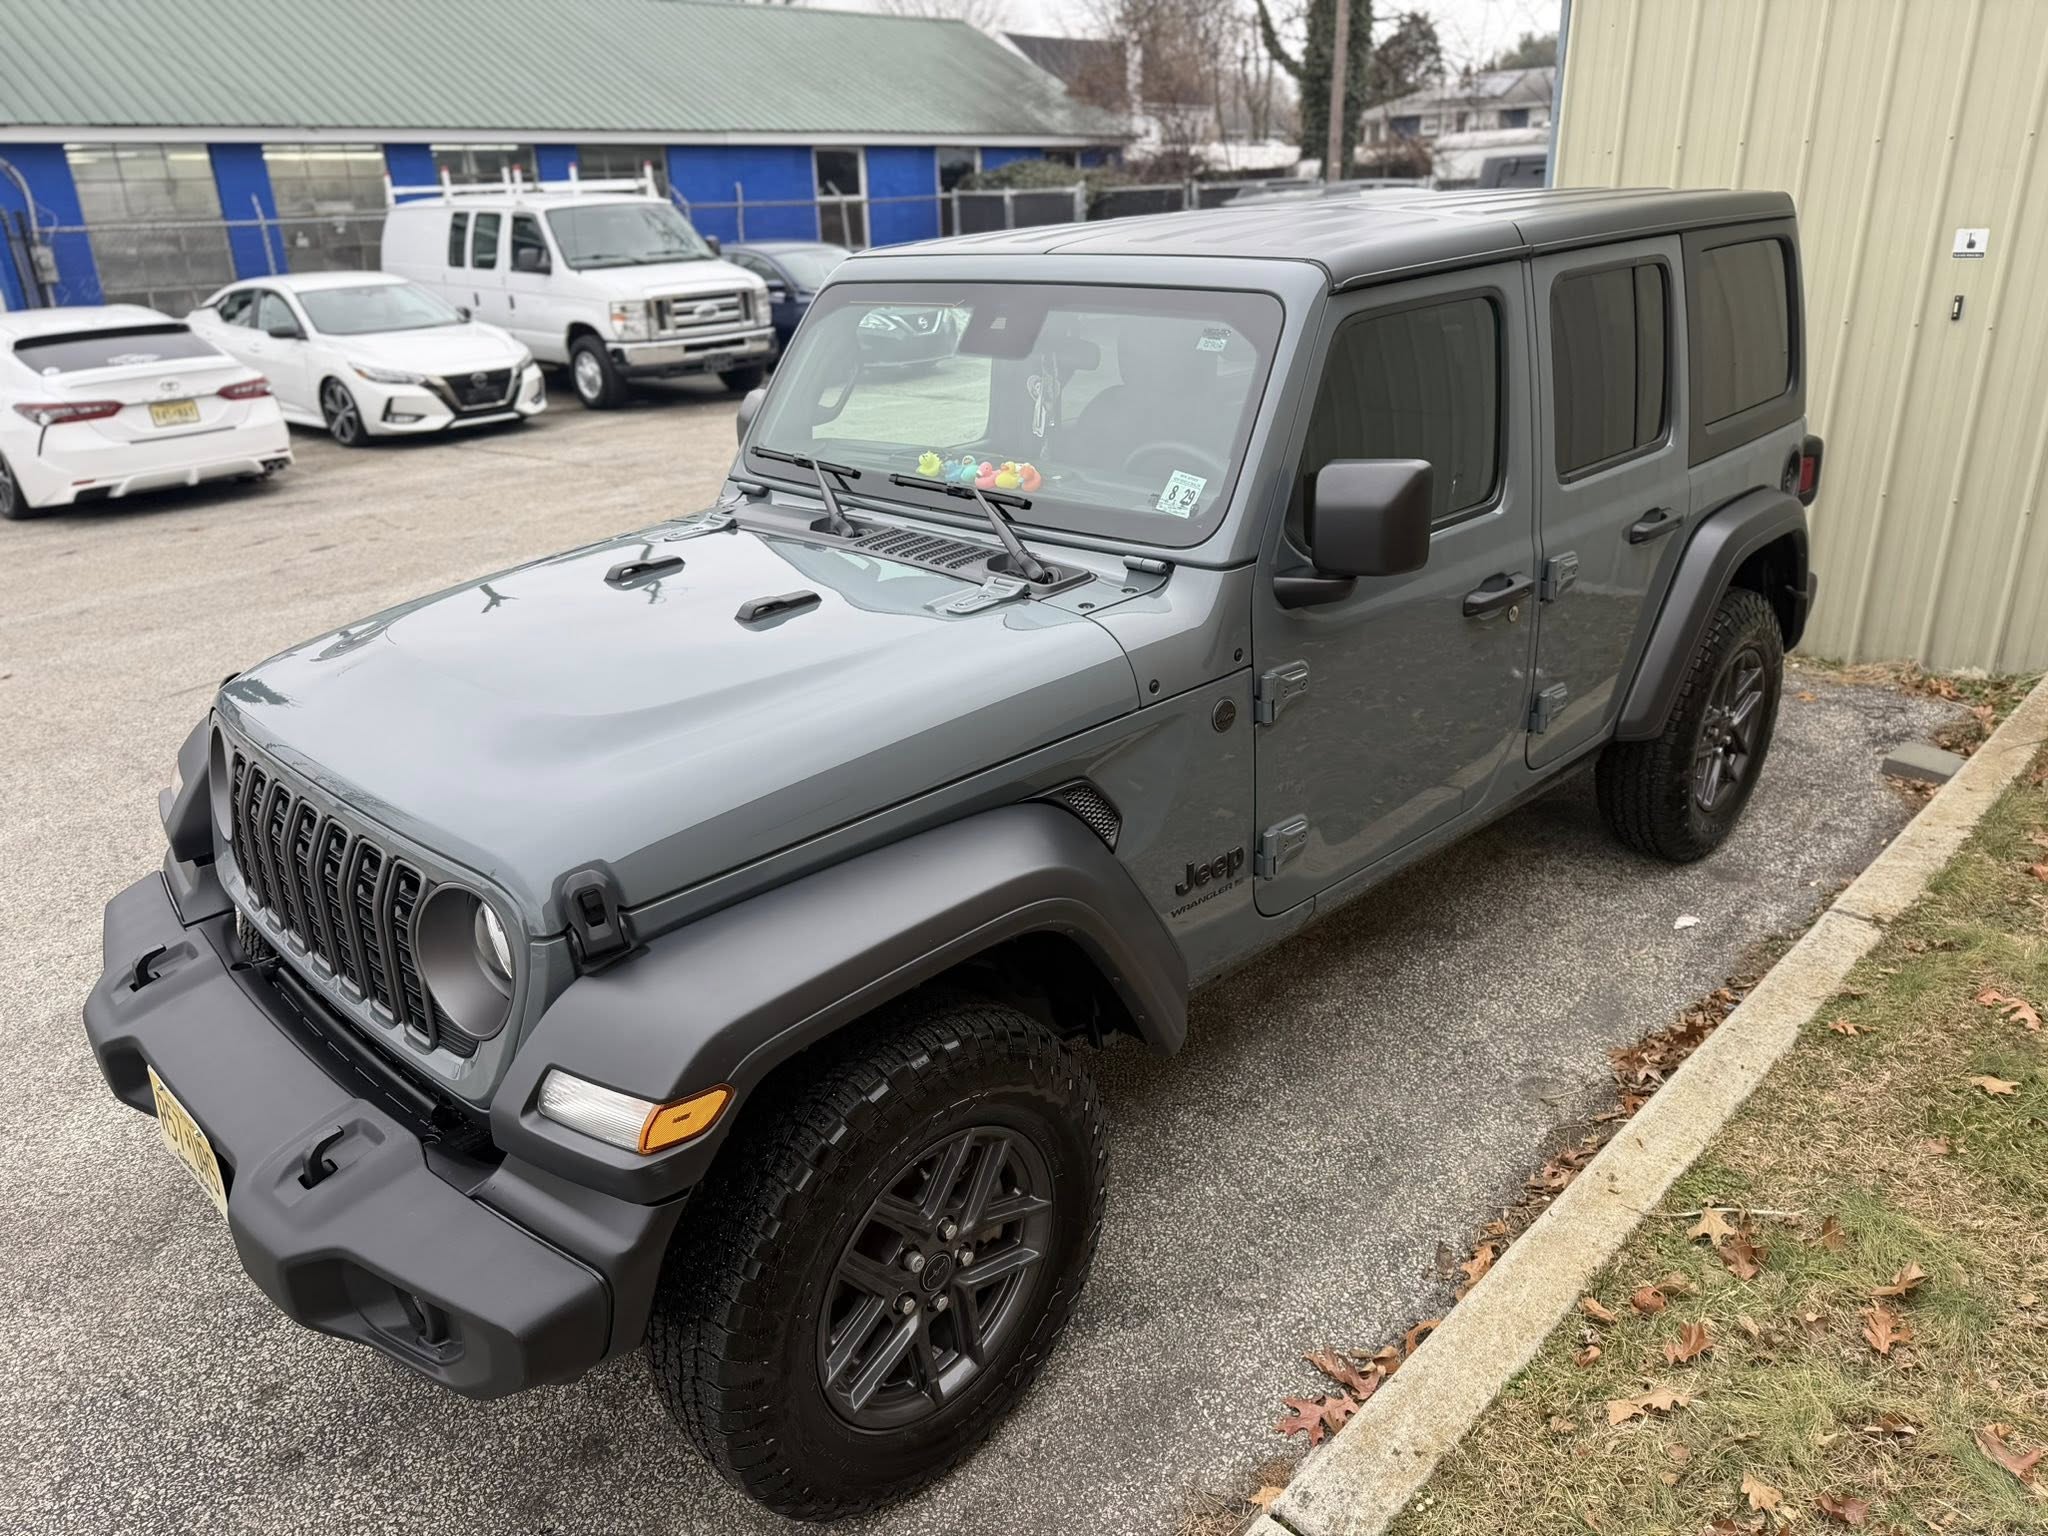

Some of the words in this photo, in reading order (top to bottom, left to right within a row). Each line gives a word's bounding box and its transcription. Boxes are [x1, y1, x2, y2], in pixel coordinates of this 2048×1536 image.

[1169, 485, 1179, 501] 8
[1180, 489, 1196, 506] 29
[1175, 846, 1245, 897] Jeep
[1170, 882, 1233, 919] WRANGLER
